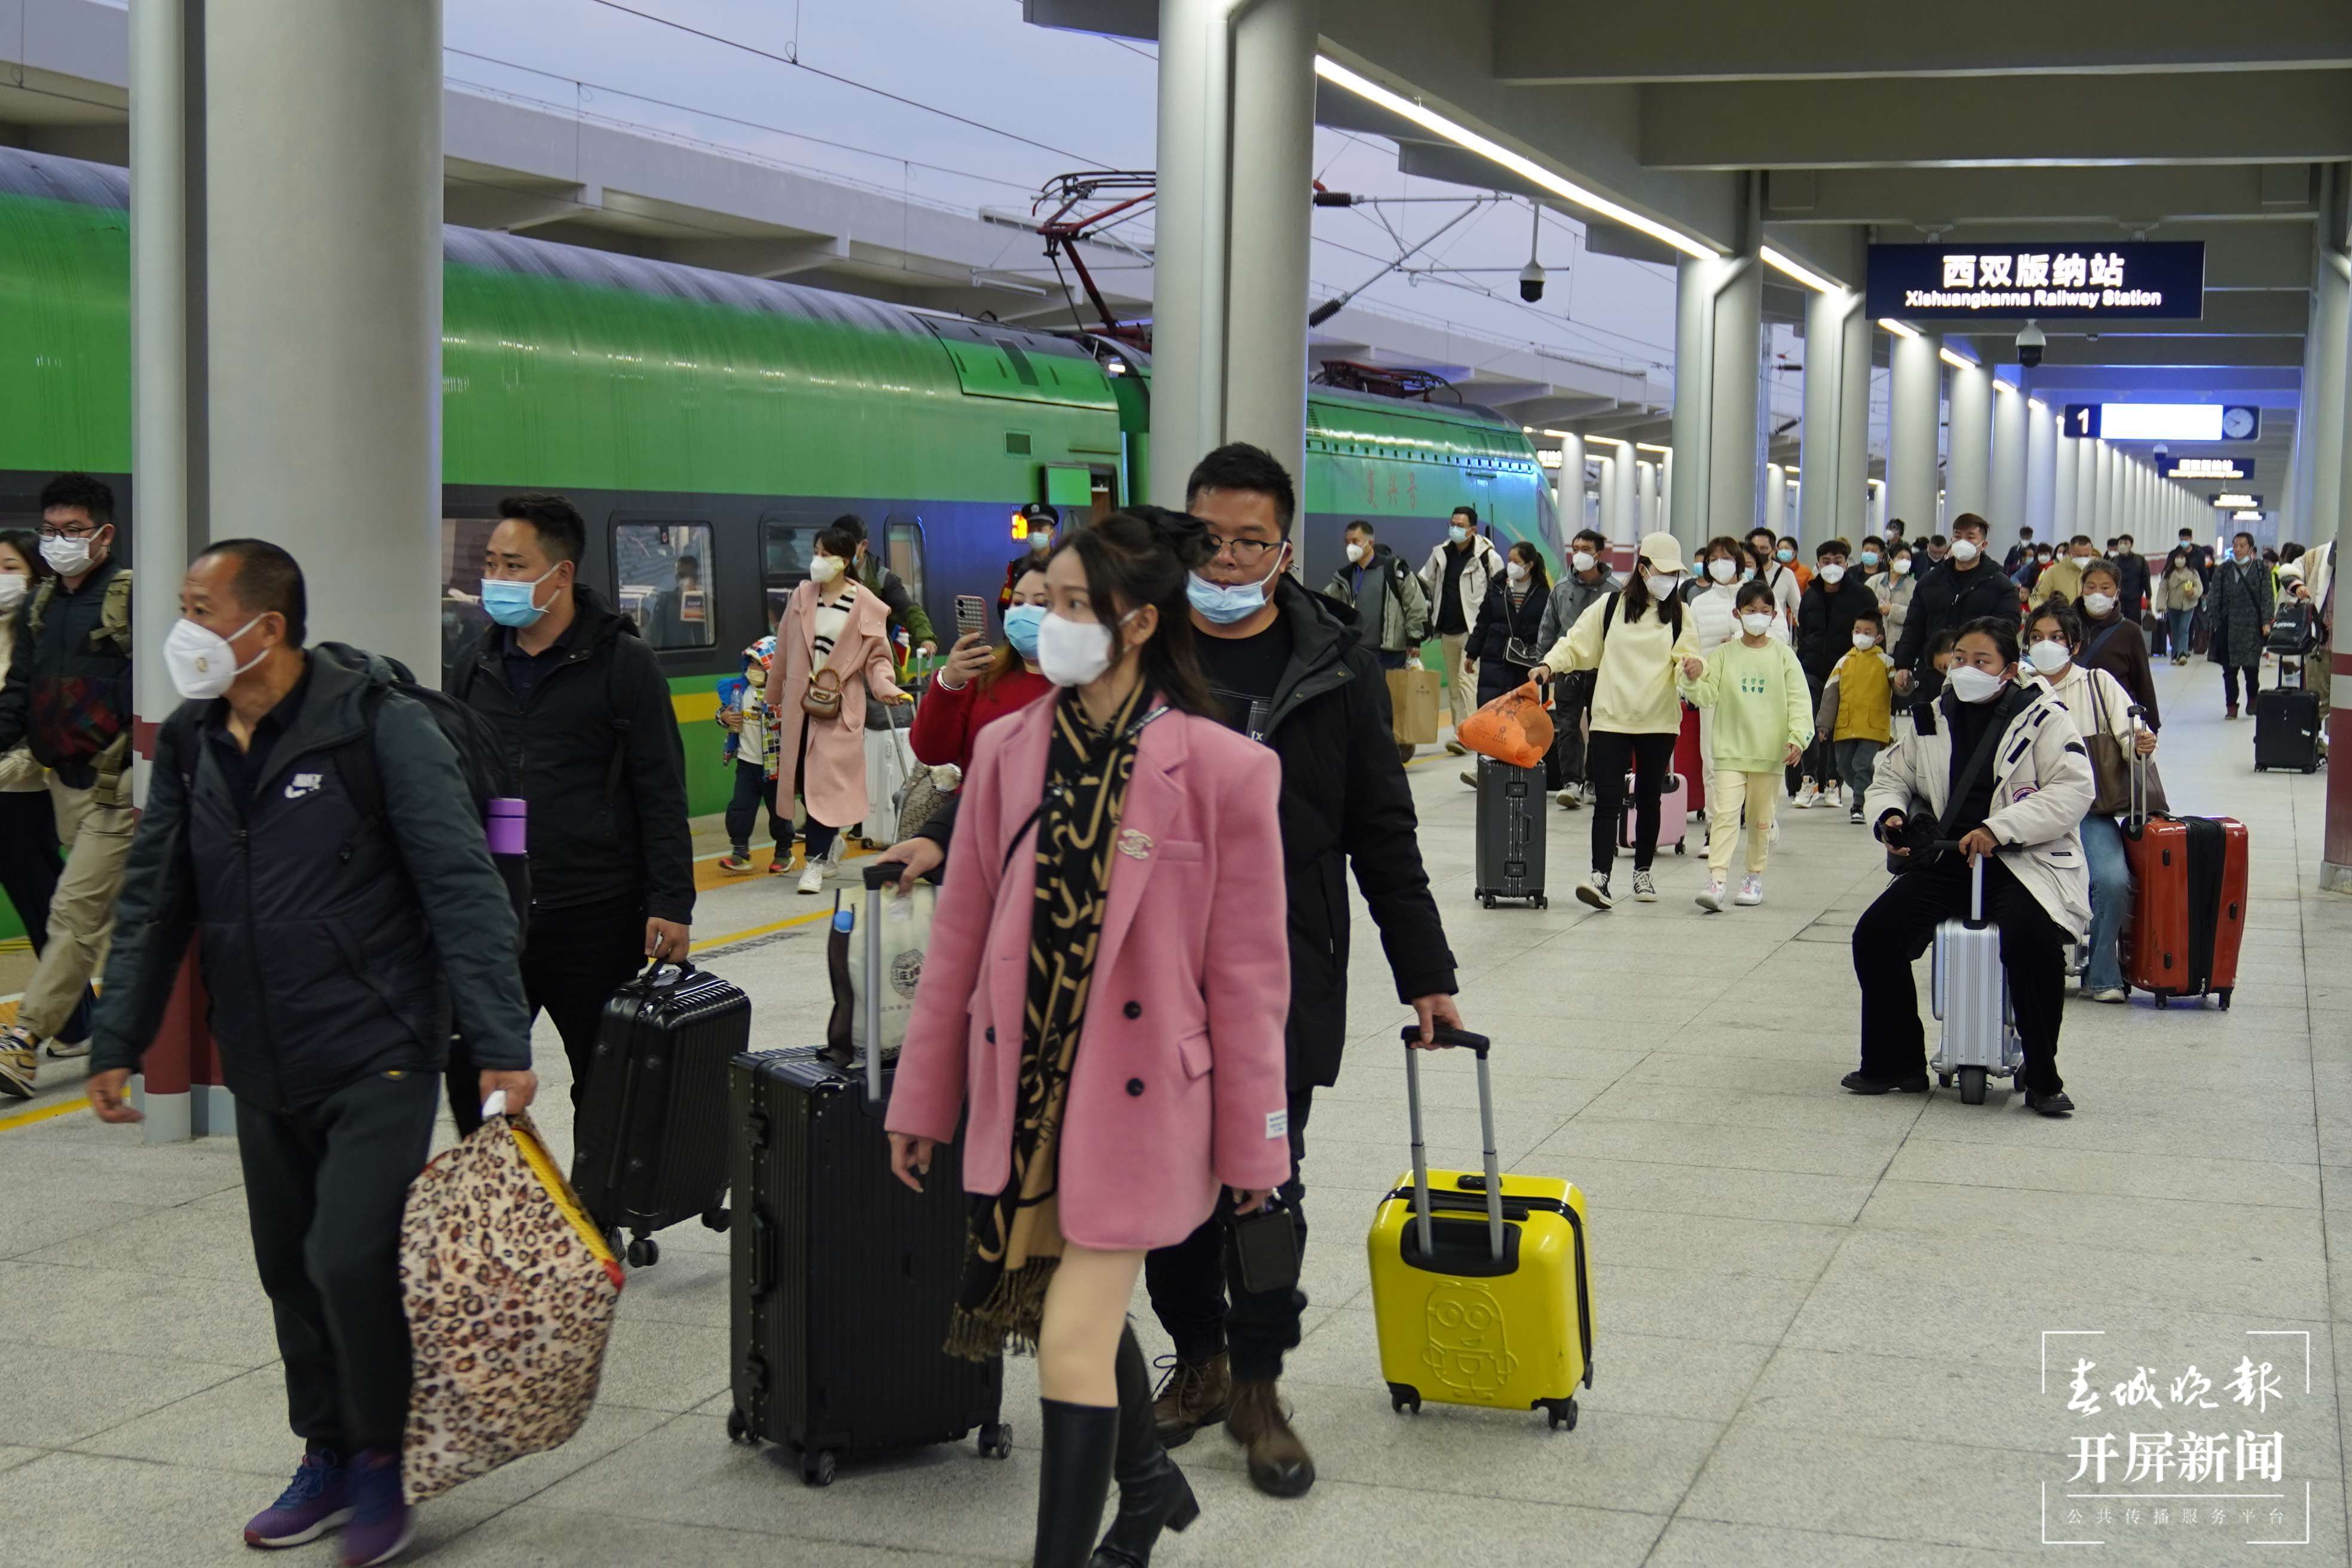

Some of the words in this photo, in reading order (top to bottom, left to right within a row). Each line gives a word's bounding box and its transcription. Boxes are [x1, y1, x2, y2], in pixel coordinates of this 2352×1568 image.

[1943, 253, 2125, 289] 西双版纳站
[2034, 289, 2100, 309] Railway
[2102, 289, 2162, 307] Station
[2077, 408, 2090, 434] 1
